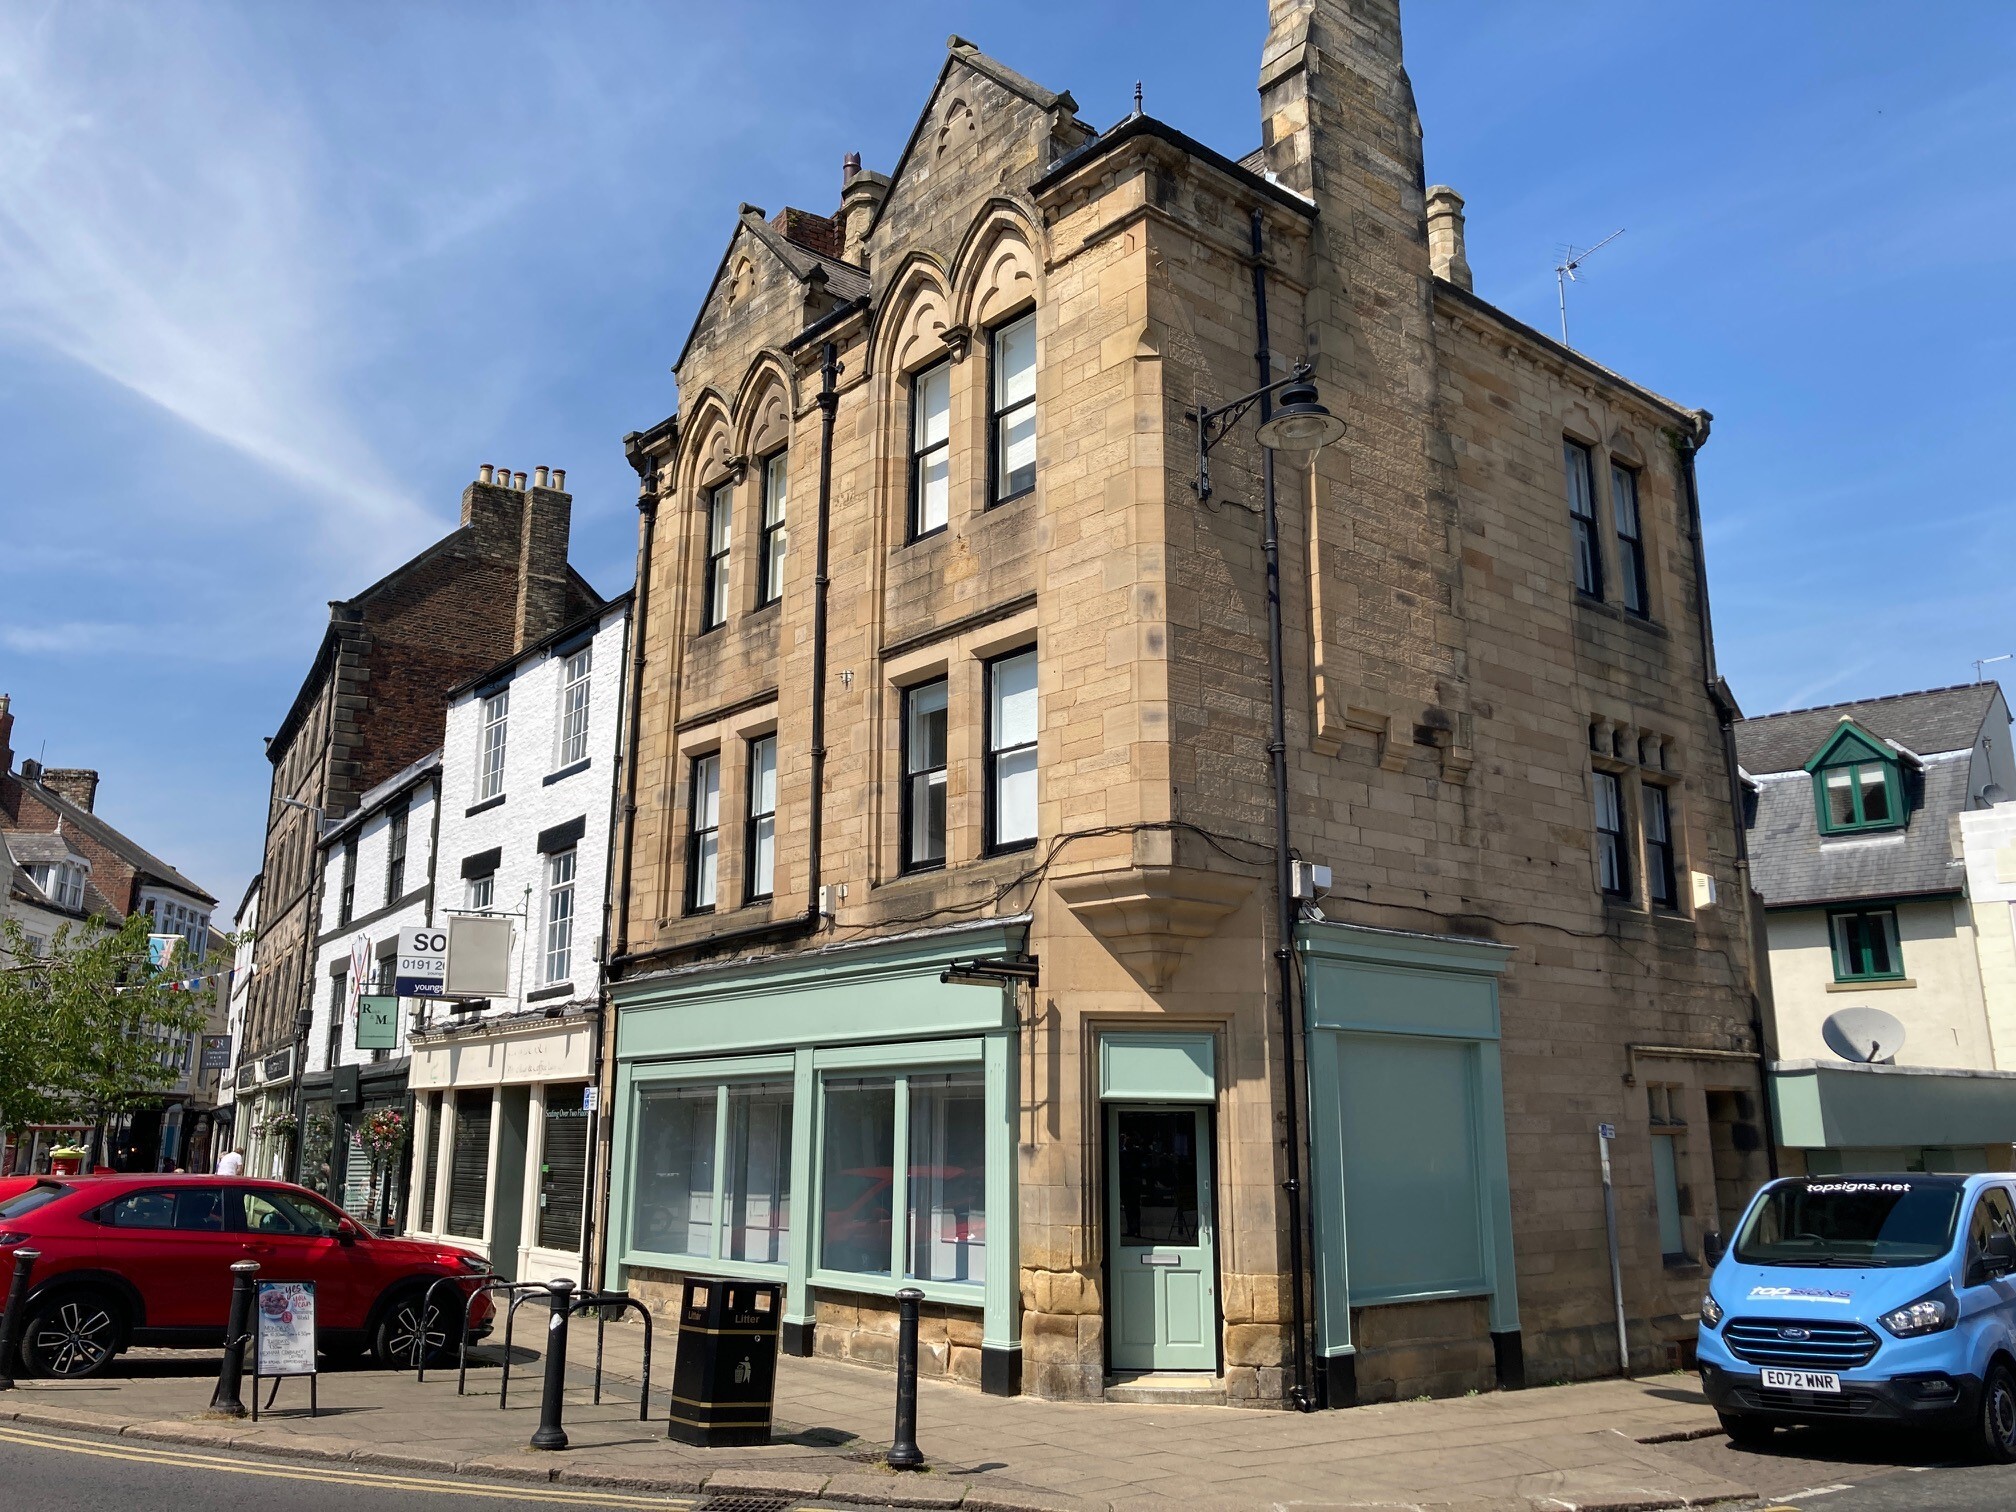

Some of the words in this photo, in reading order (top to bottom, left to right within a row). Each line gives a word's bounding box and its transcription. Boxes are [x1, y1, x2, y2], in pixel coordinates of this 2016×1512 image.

[402, 959, 431, 970] 0191
[560, 1108, 569, 1117] Over
[569, 1108, 578, 1117] Two
[1806, 1181, 1911, 1194] topsigns.net
[285, 1284, 302, 1300] yes
[735, 1314, 760, 1324] Litter
[1805, 1374, 1834, 1389] WNR
